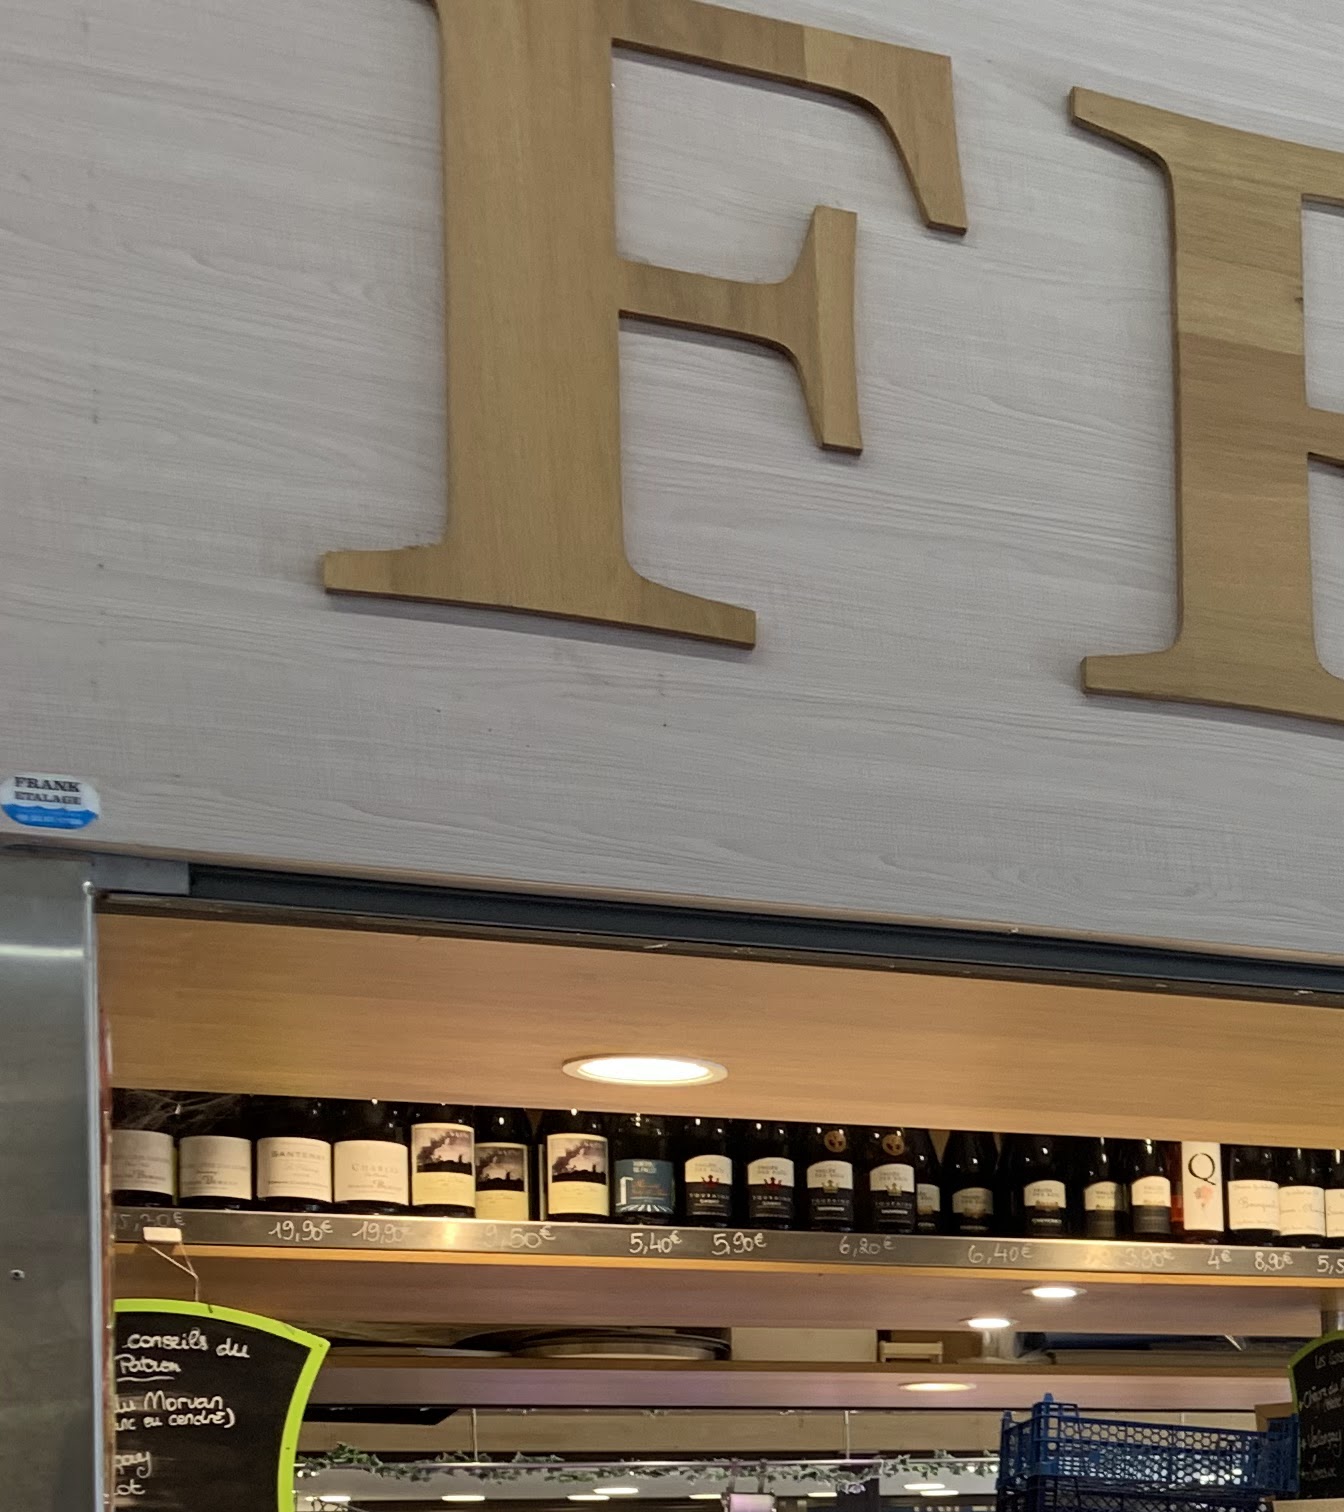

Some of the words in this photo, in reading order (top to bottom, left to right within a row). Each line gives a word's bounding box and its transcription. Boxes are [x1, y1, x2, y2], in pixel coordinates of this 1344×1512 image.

[14, 776, 81, 793] FRANK
[14, 790, 82, 805] ETALAGE
[1188, 1152, 1217, 1186] Q
[268, 1219, 333, 1241] 19,90€
[629, 1230, 682, 1254] 5,40€
[711, 1232, 767, 1255] 5,90€
[1207, 1248, 1232, 1270] 4€
[1254, 1251, 1293, 1272] 8,90€
[121, 1326, 209, 1352] conseils
[143, 1390, 224, 1412] Morvan
